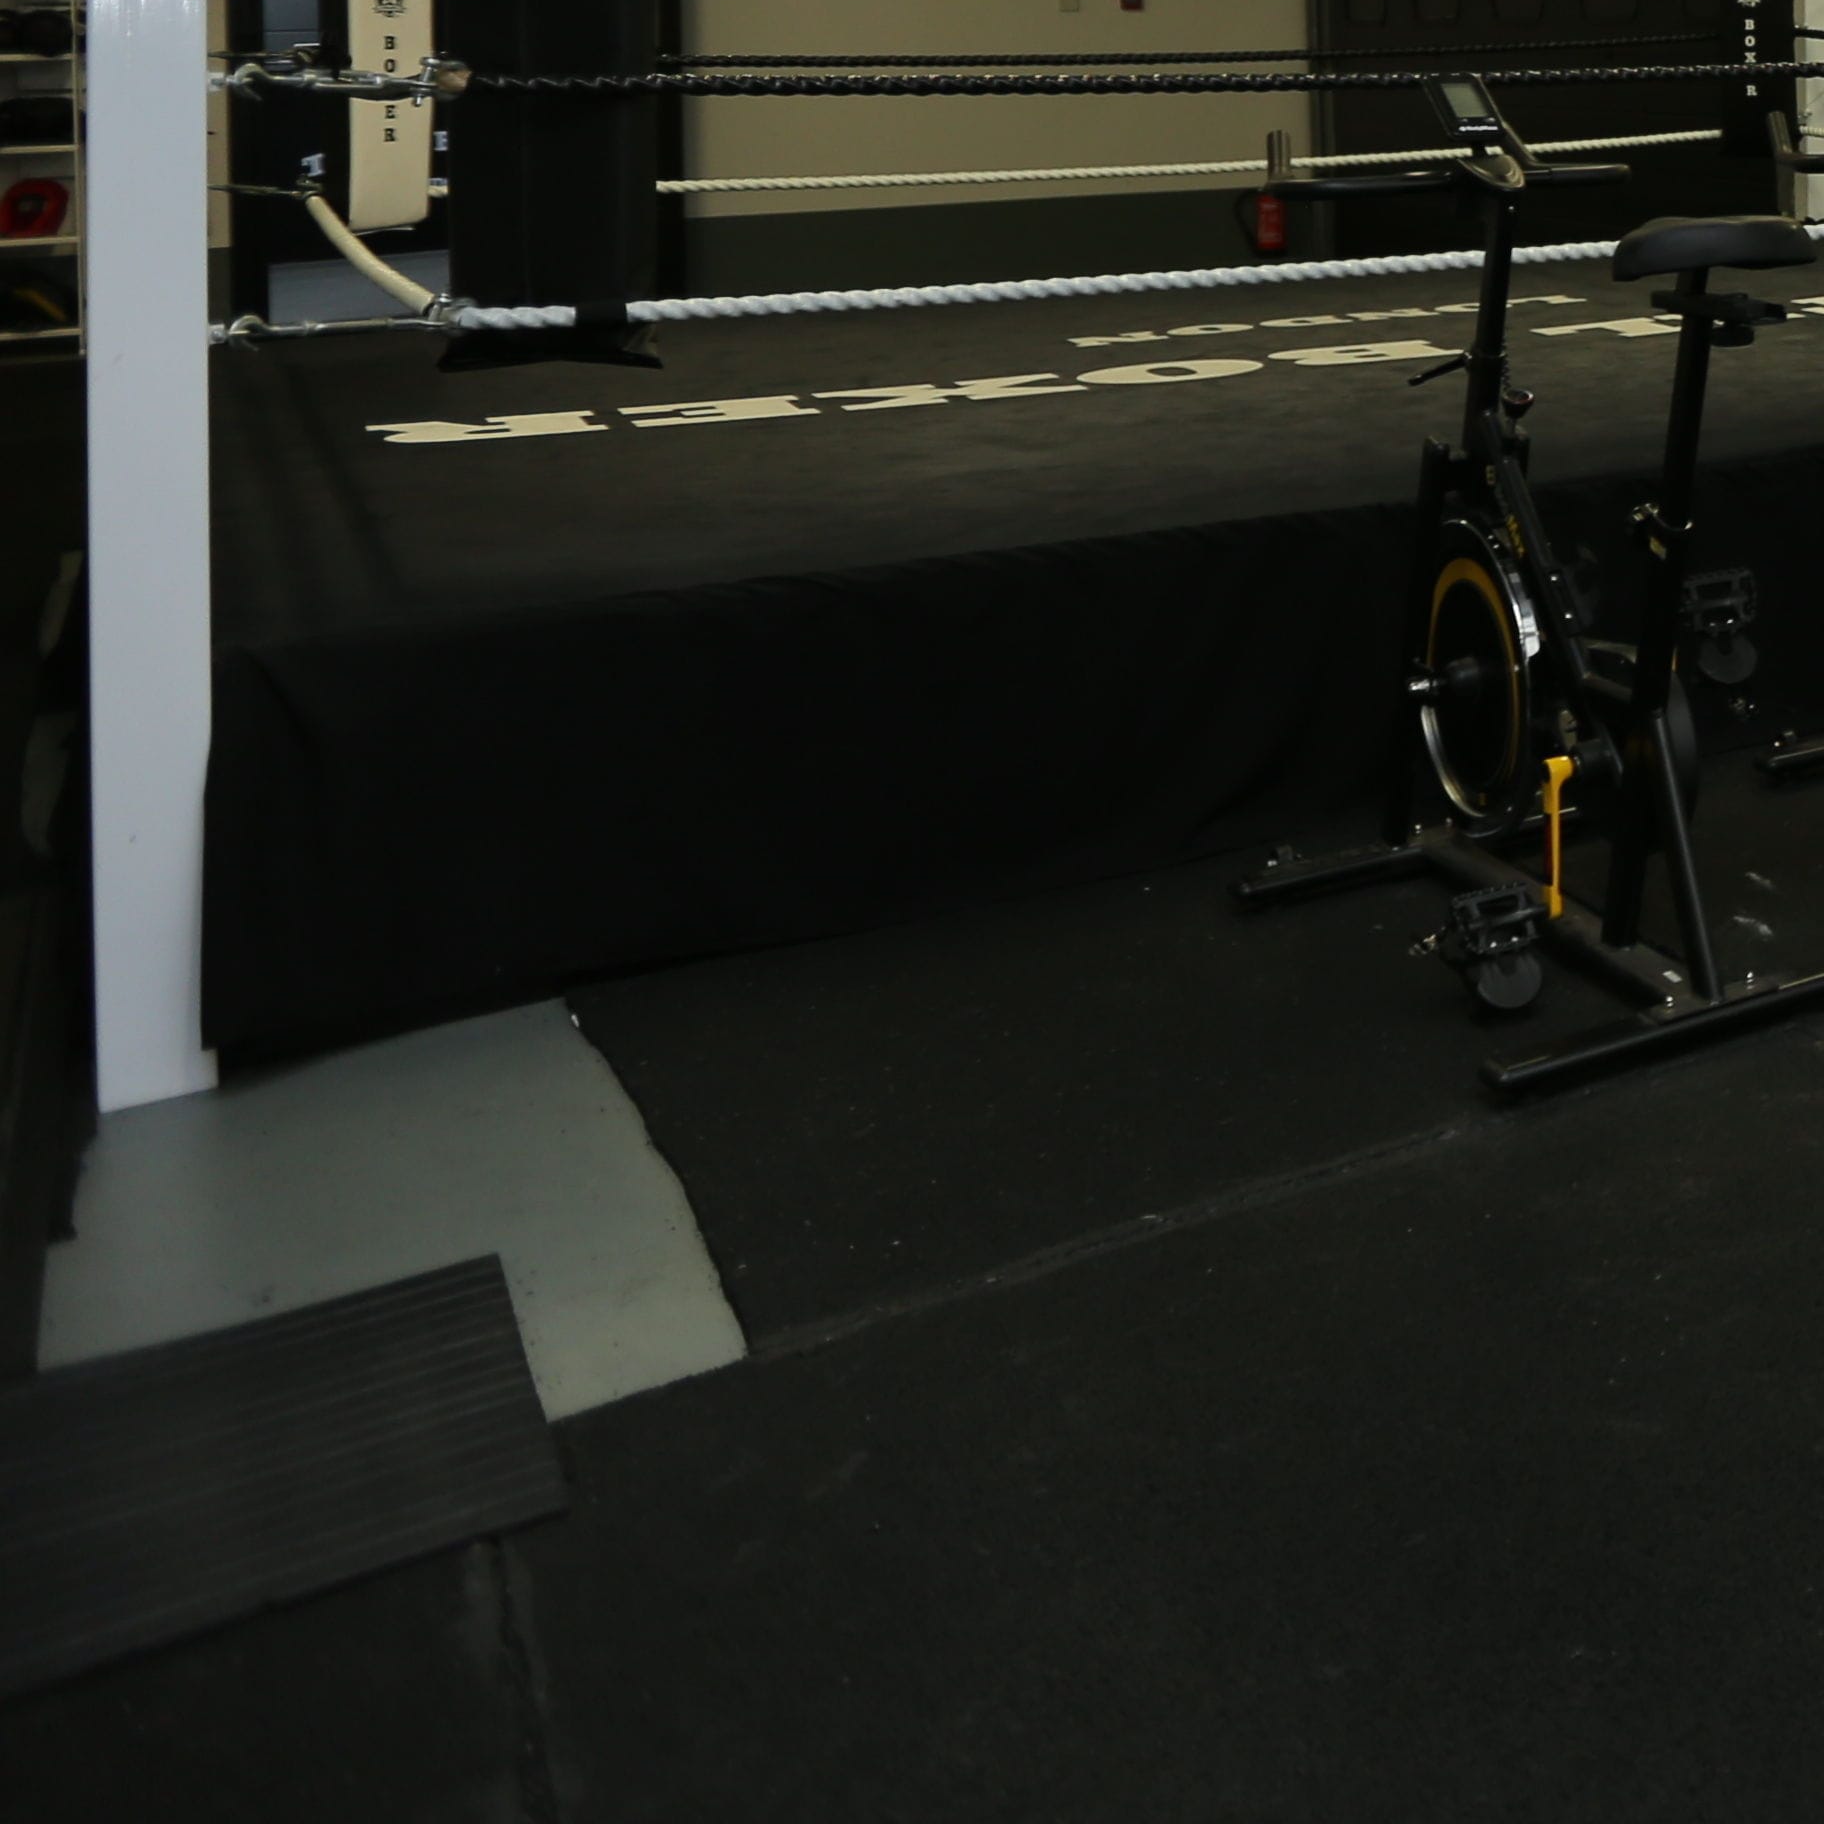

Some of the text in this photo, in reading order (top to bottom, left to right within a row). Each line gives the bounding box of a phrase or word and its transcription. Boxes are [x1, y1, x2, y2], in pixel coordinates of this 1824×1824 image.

[384, 36, 397, 142] BOER
[1743, 19, 1758, 96] BOXR
[365, 339, 1464, 443] BOXER
